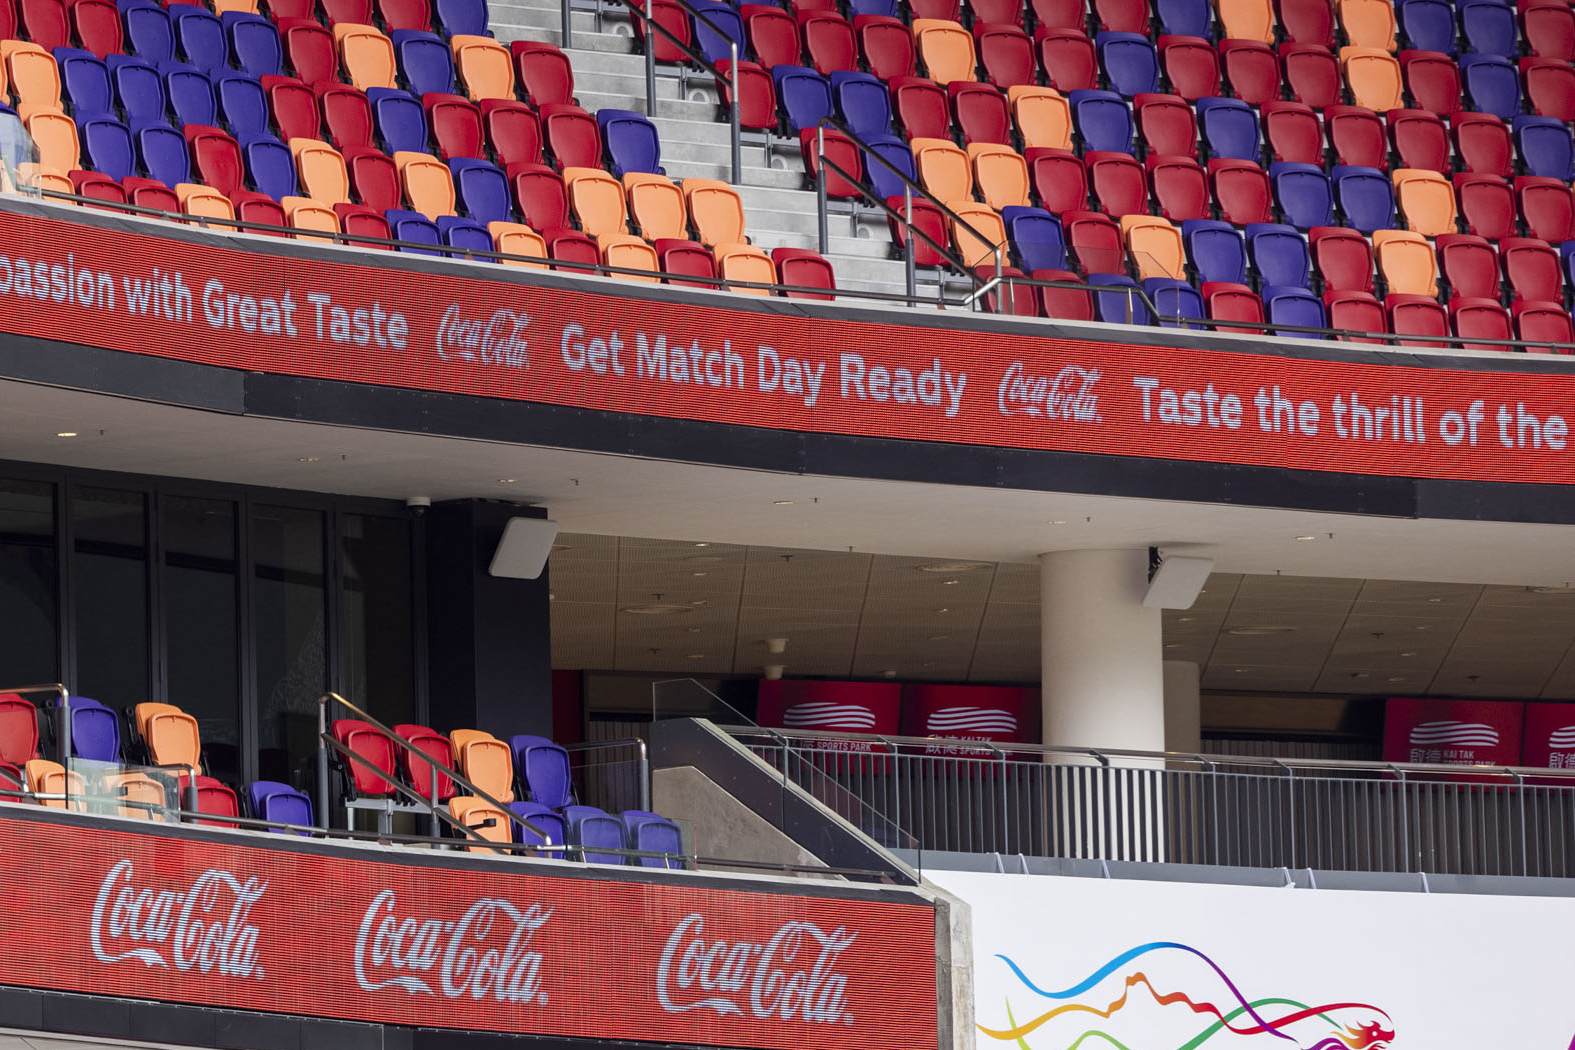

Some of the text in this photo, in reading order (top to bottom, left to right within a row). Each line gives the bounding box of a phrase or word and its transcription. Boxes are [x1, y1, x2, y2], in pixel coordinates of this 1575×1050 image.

[123, 267, 192, 322] with
[202, 278, 298, 337] Great
[308, 291, 409, 350] Taste
[560, 322, 967, 418] Get Match Day Ready
[1133, 376, 1568, 450] Taste the thrill of the
[850, 743, 871, 752] PARK
[1459, 751, 1474, 760] TAK
